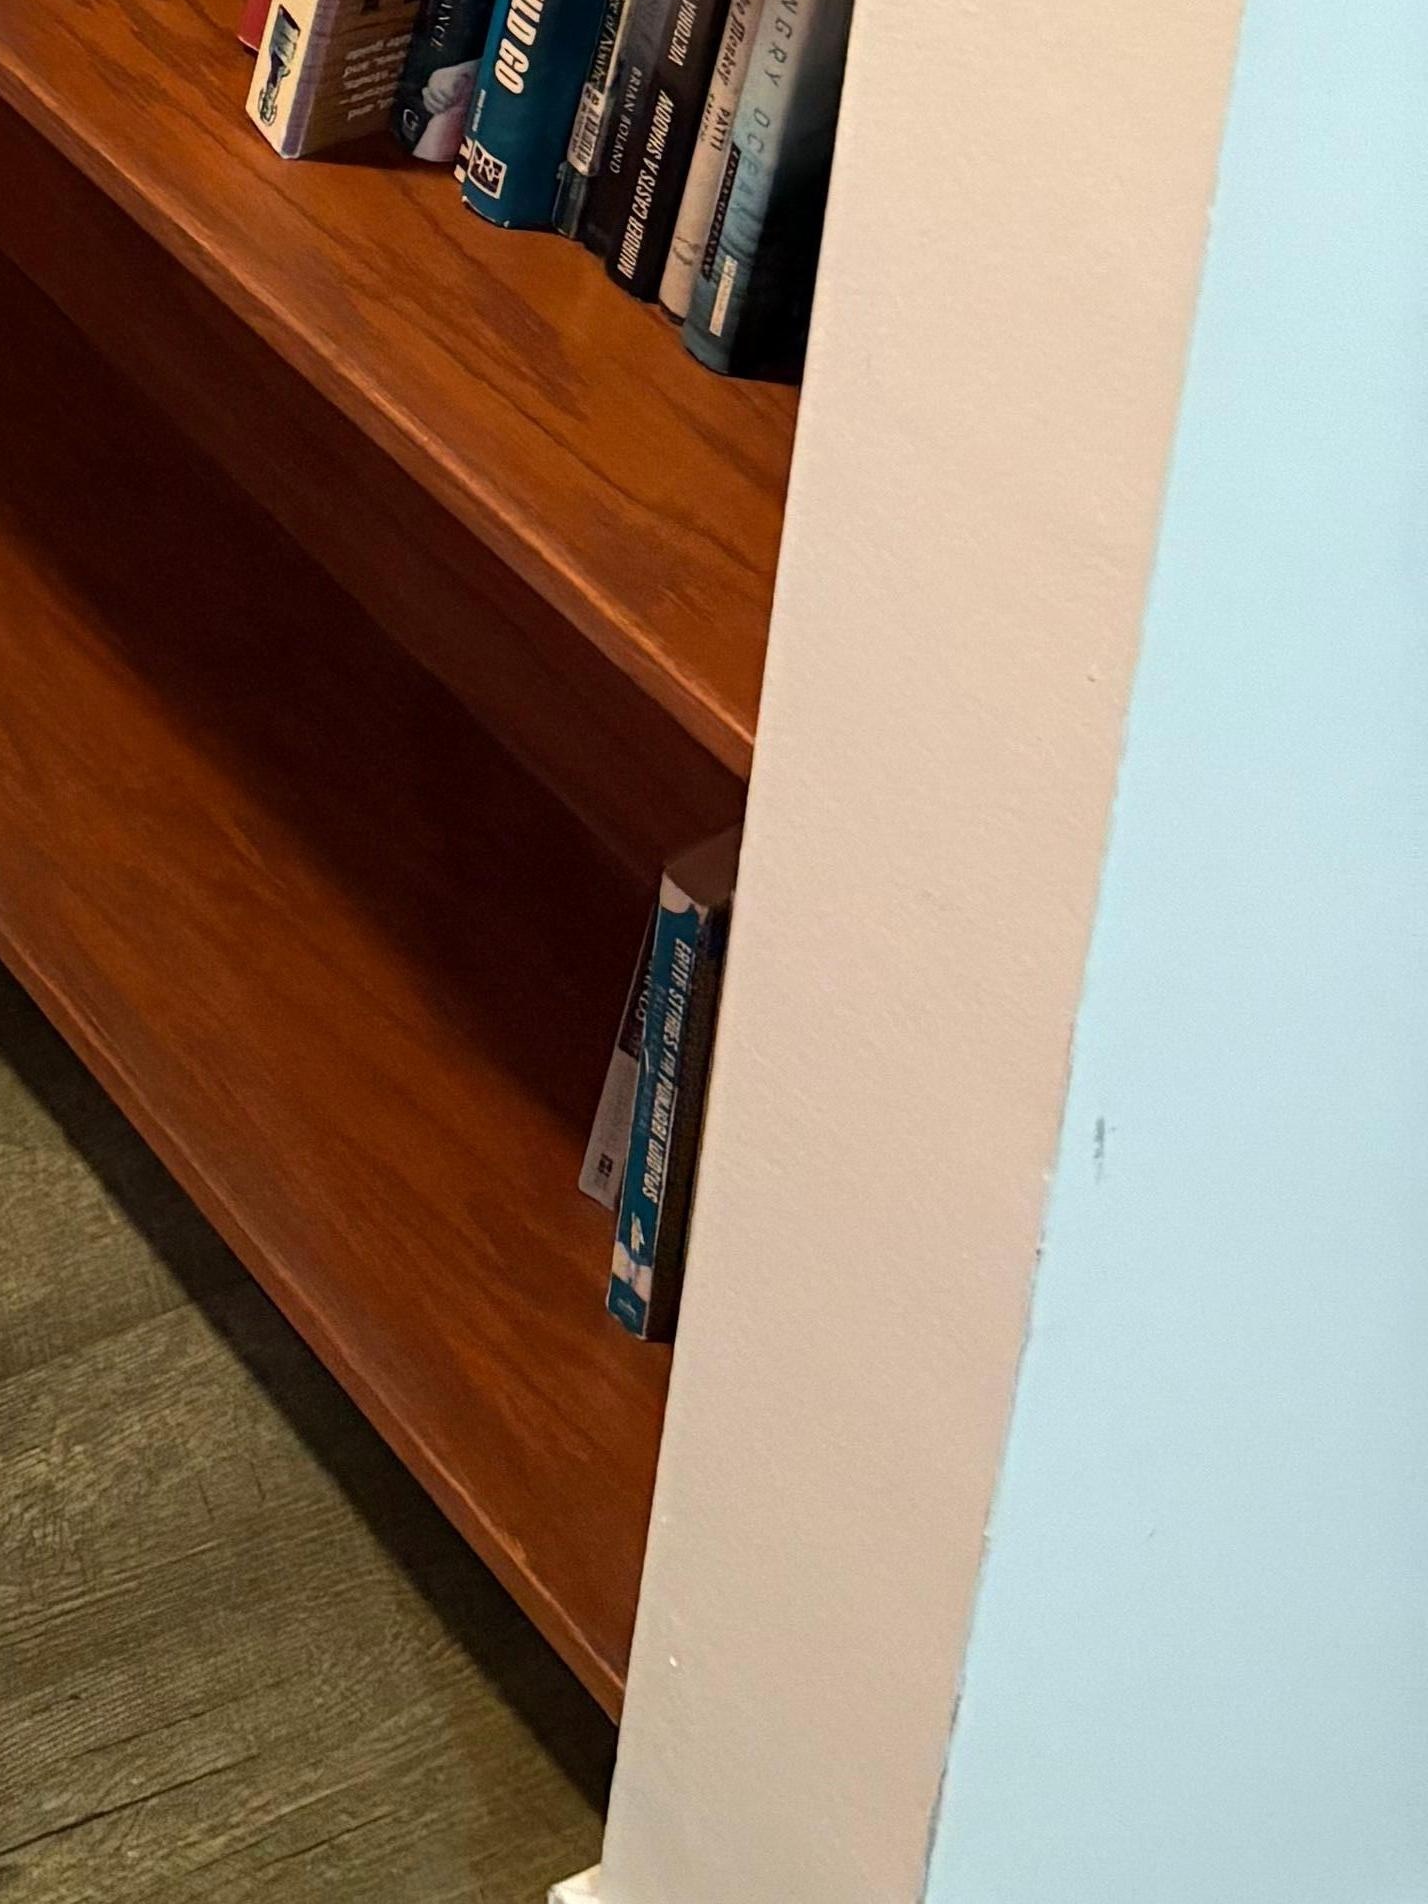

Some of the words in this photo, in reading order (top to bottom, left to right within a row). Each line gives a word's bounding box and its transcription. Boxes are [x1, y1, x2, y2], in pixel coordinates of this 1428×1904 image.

[493, 37, 531, 95] GO
[645, 88, 677, 160] SHADOW
[709, 106, 731, 154] PATTI
[630, 166, 656, 225] CASTS
[616, 213, 646, 282] MURDER
